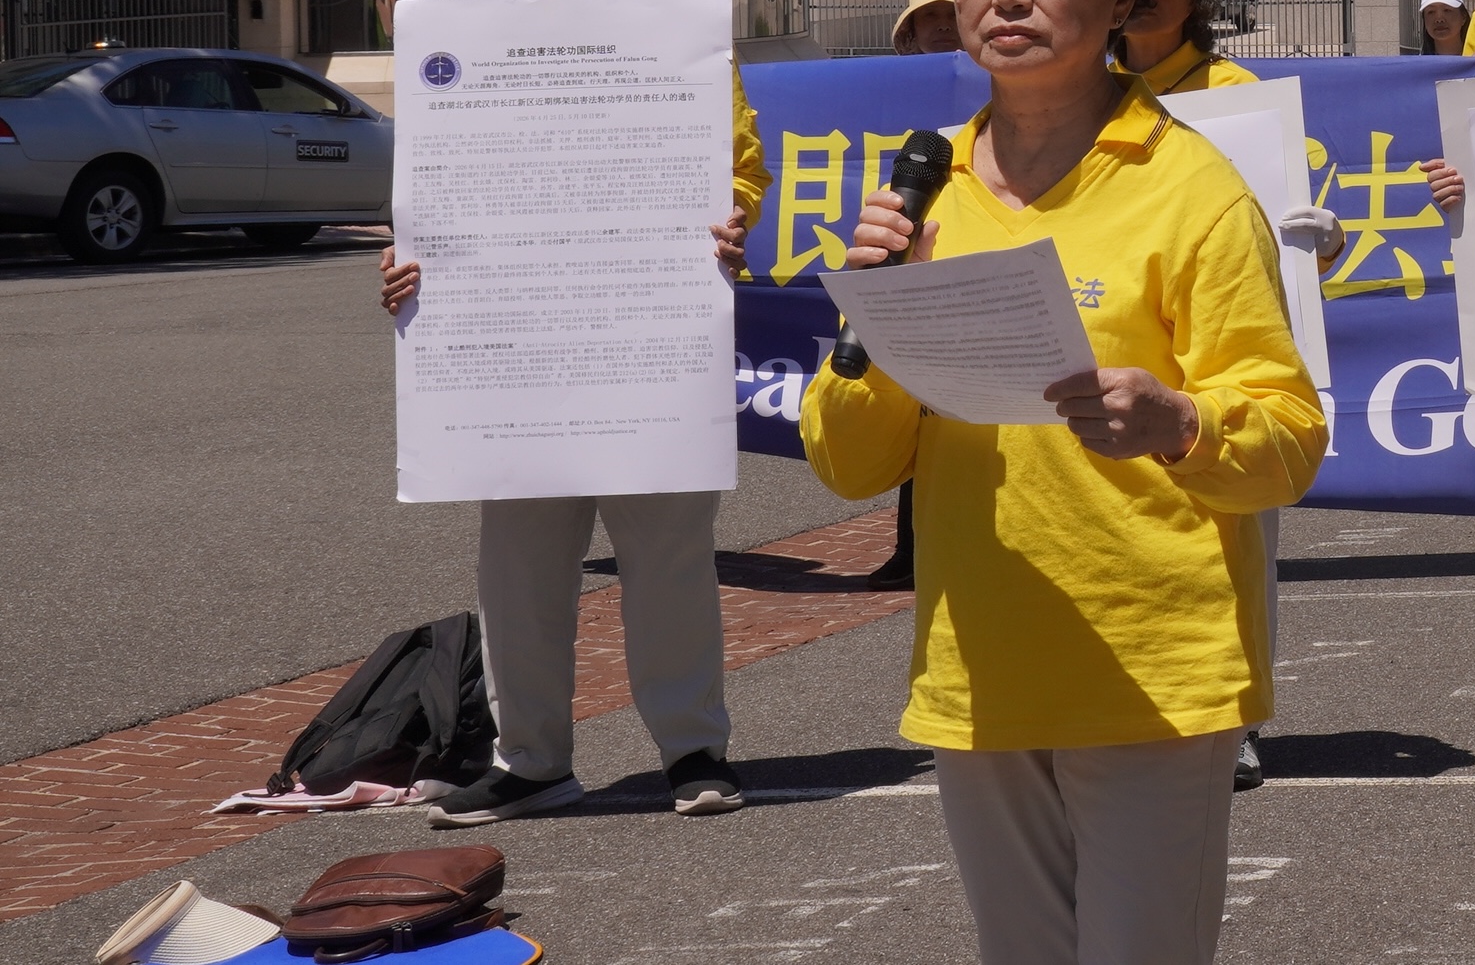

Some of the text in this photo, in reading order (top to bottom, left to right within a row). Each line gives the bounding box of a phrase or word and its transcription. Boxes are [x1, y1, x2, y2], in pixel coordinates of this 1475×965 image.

[472, 60, 488, 68] World
[491, 58, 530, 68] Organization
[538, 56, 570, 66] Investigate
[581, 56, 614, 64] Persecution
[642, 55, 658, 63] Gong
[298, 145, 346, 157] SECURITY
